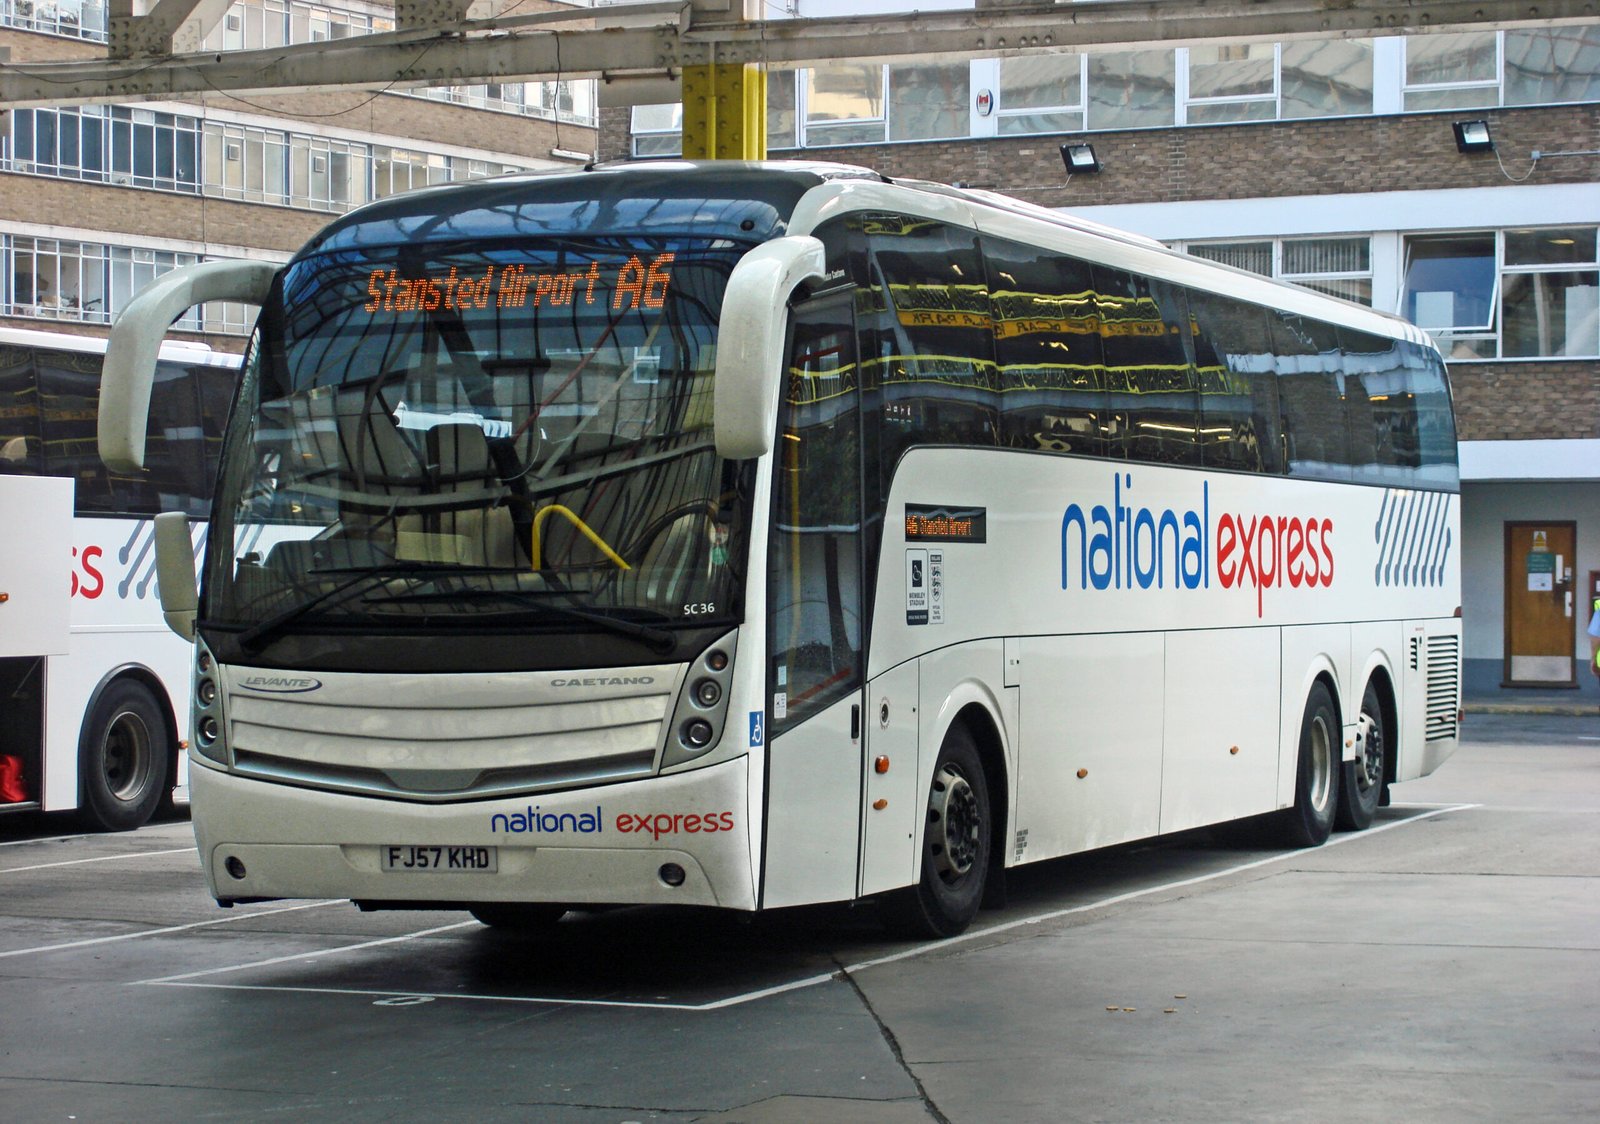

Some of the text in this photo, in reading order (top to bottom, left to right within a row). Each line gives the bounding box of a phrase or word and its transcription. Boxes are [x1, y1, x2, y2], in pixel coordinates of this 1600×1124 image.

[364, 252, 675, 312] Stansted Airport A6
[1061, 472, 1334, 618] national express
[683, 602, 715, 615] SC 36
[245, 677, 311, 688] LEVANTE
[550, 676, 655, 687] CAETANO
[492, 806, 734, 840] national express
[388, 848, 490, 869] FJ57 KHD
